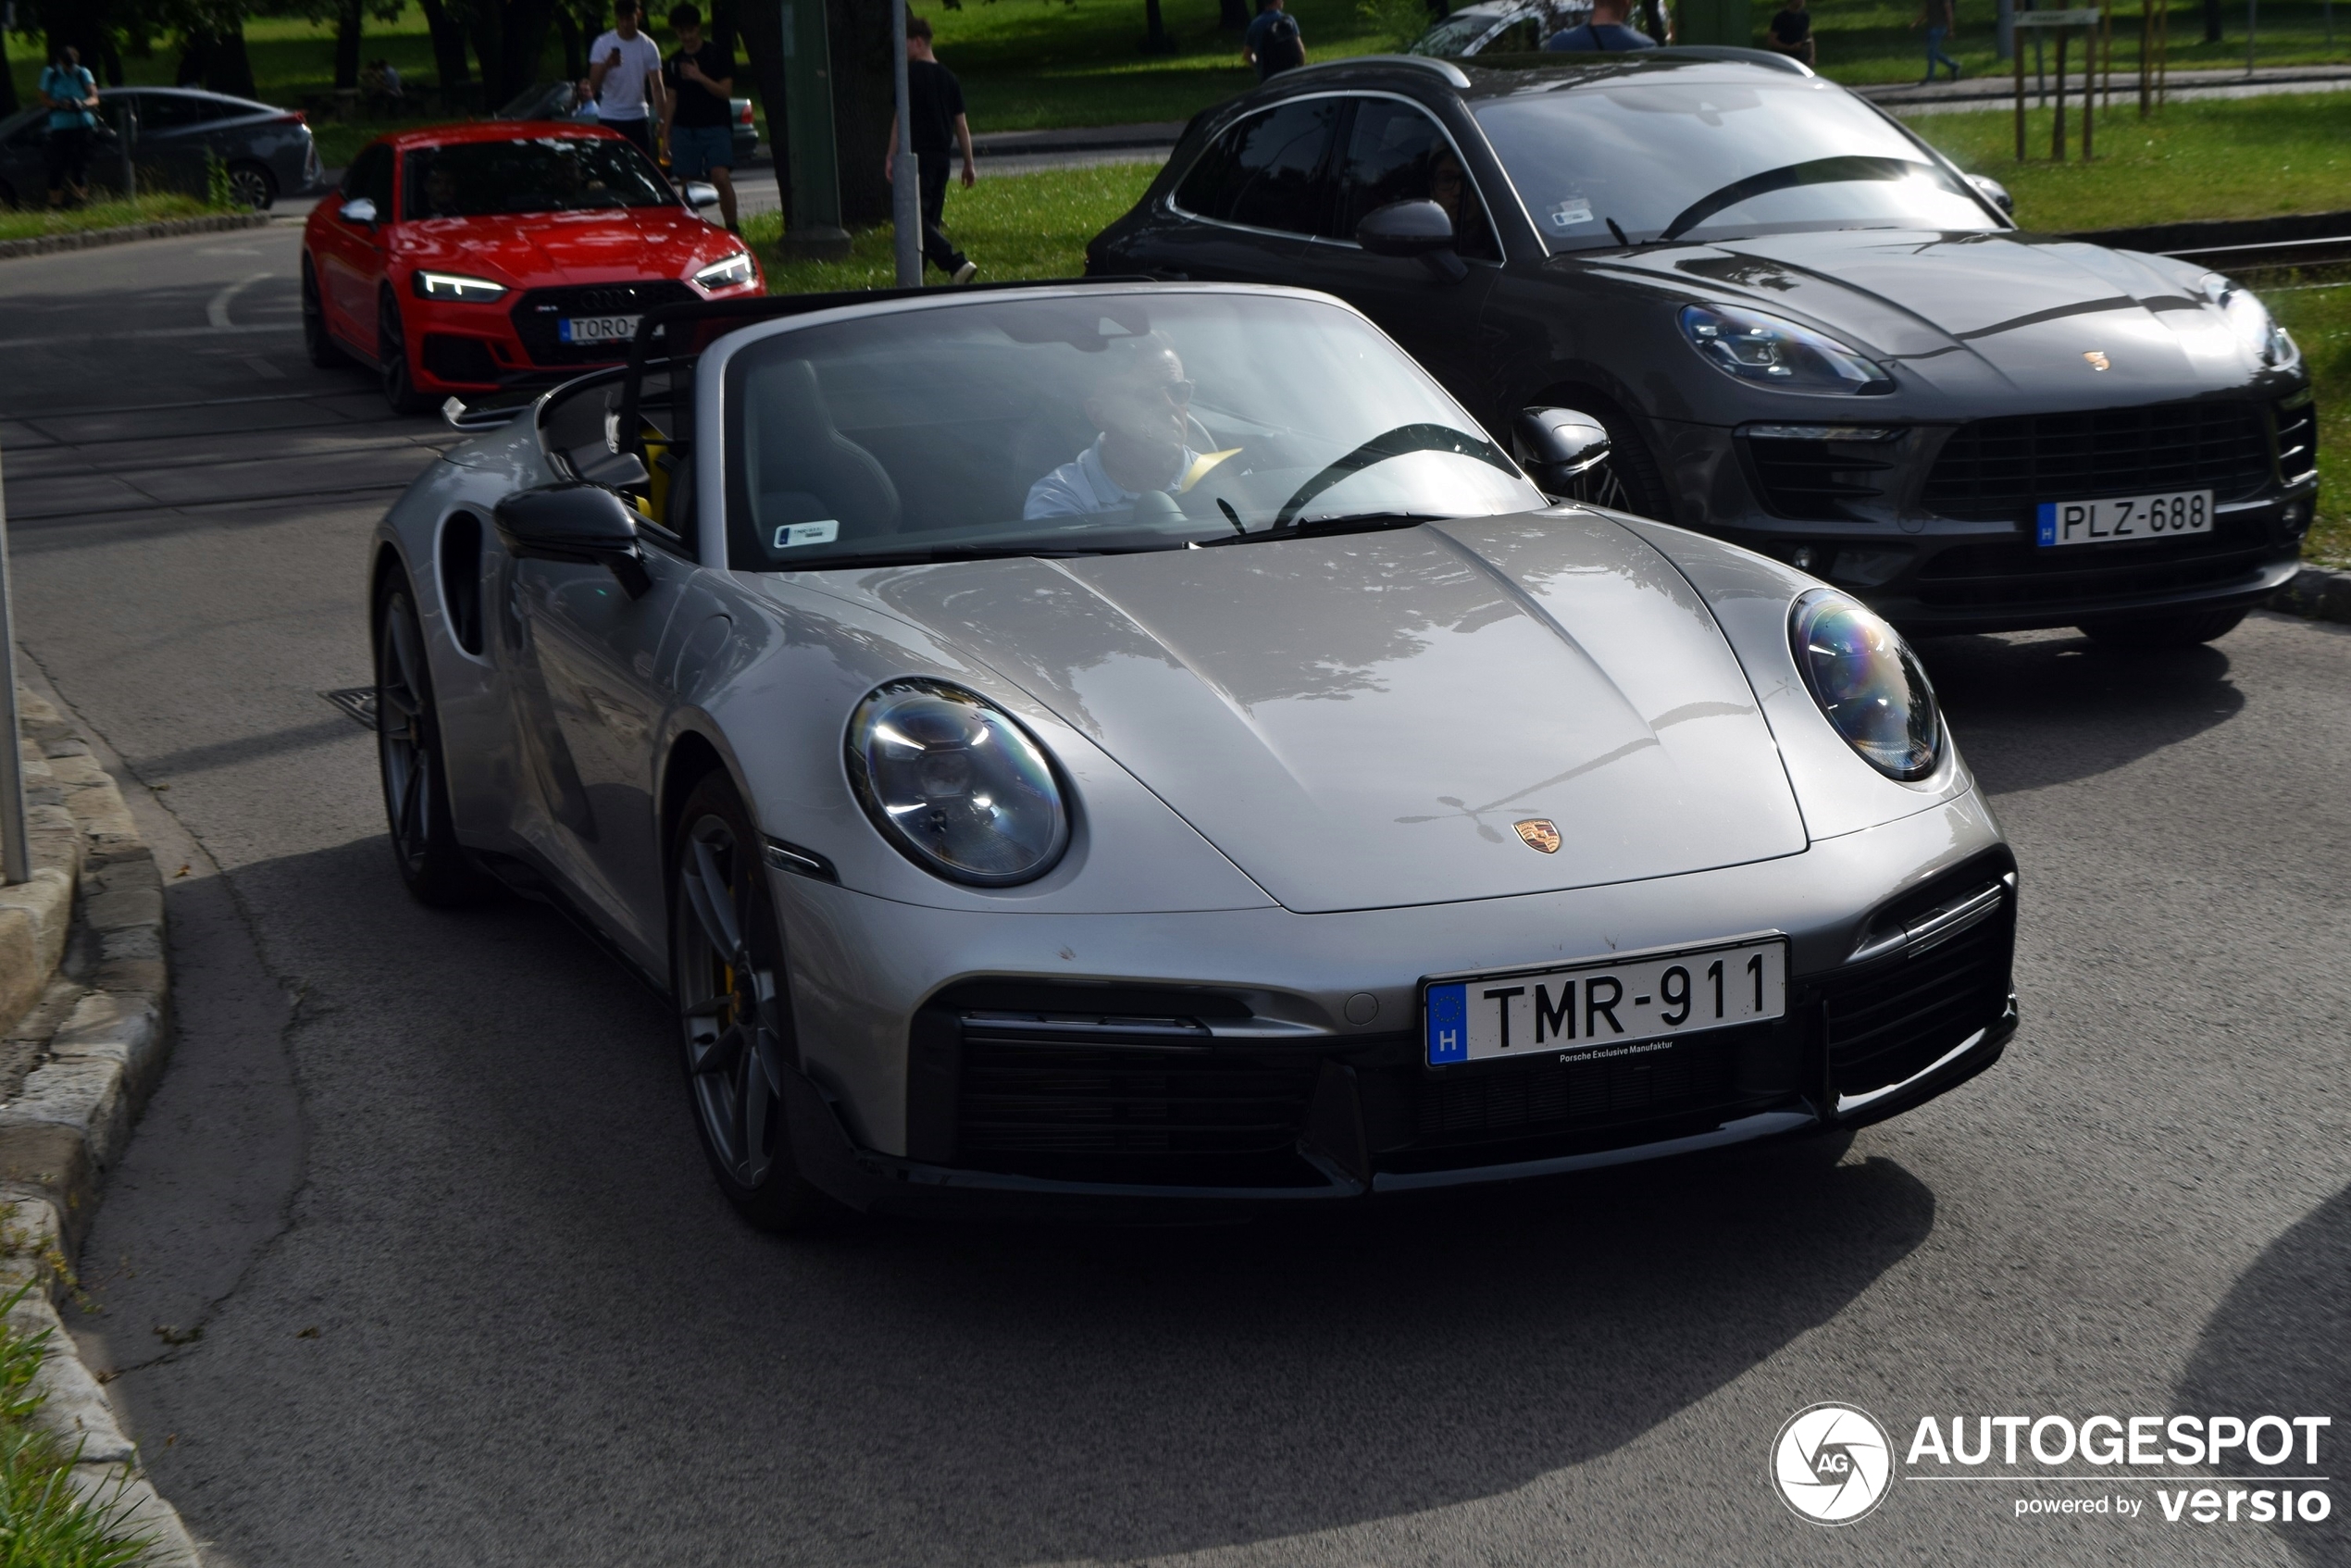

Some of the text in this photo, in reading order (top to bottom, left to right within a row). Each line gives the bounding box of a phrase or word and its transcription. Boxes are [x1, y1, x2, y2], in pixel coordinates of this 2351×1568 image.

[573, 317, 636, 338] TORO-
[2063, 494, 2205, 541] PLZ-688
[2042, 528, 2053, 540] H
[1483, 952, 1763, 1048] TMR-911
[1439, 1029, 1457, 1052] H
[1560, 1041, 1673, 1063] Porsche Exclusive Manufaktur
